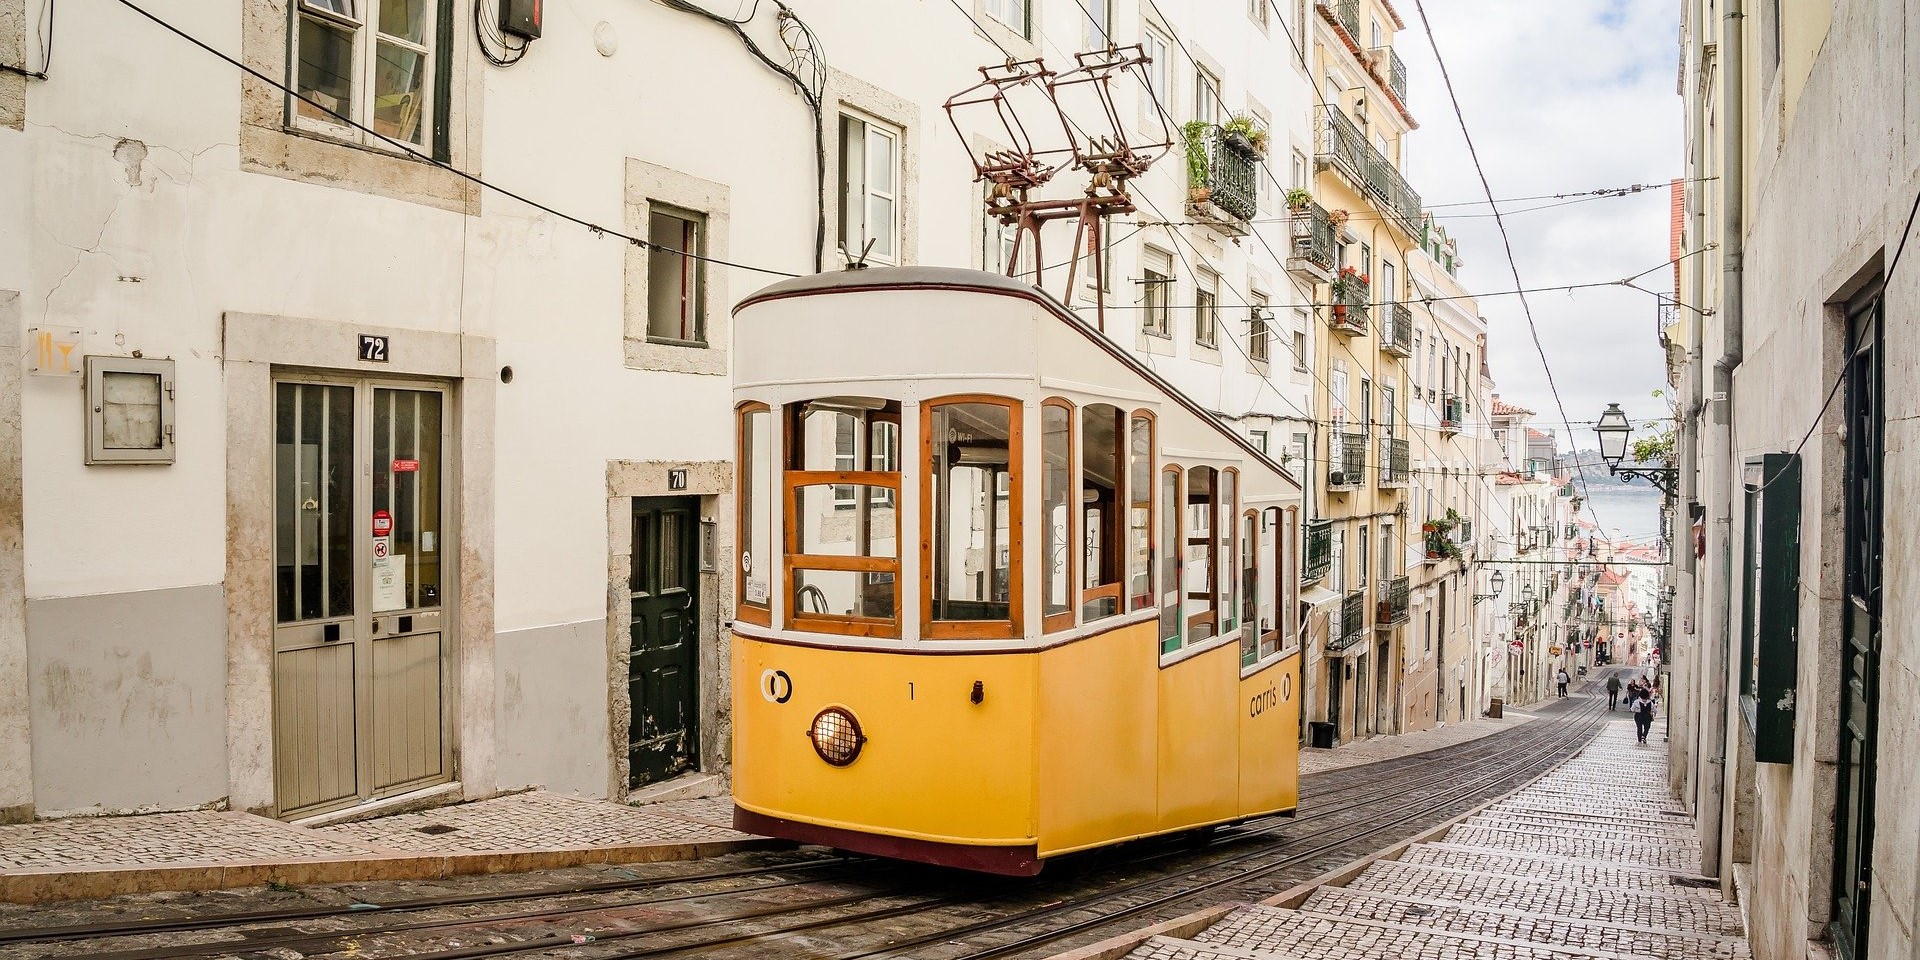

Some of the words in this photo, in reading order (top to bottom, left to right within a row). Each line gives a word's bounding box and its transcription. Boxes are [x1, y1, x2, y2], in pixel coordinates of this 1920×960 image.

[364, 336, 384, 360] 72
[672, 471, 685, 488] 70
[908, 681, 915, 701] 1
[1250, 680, 1277, 718] carris
